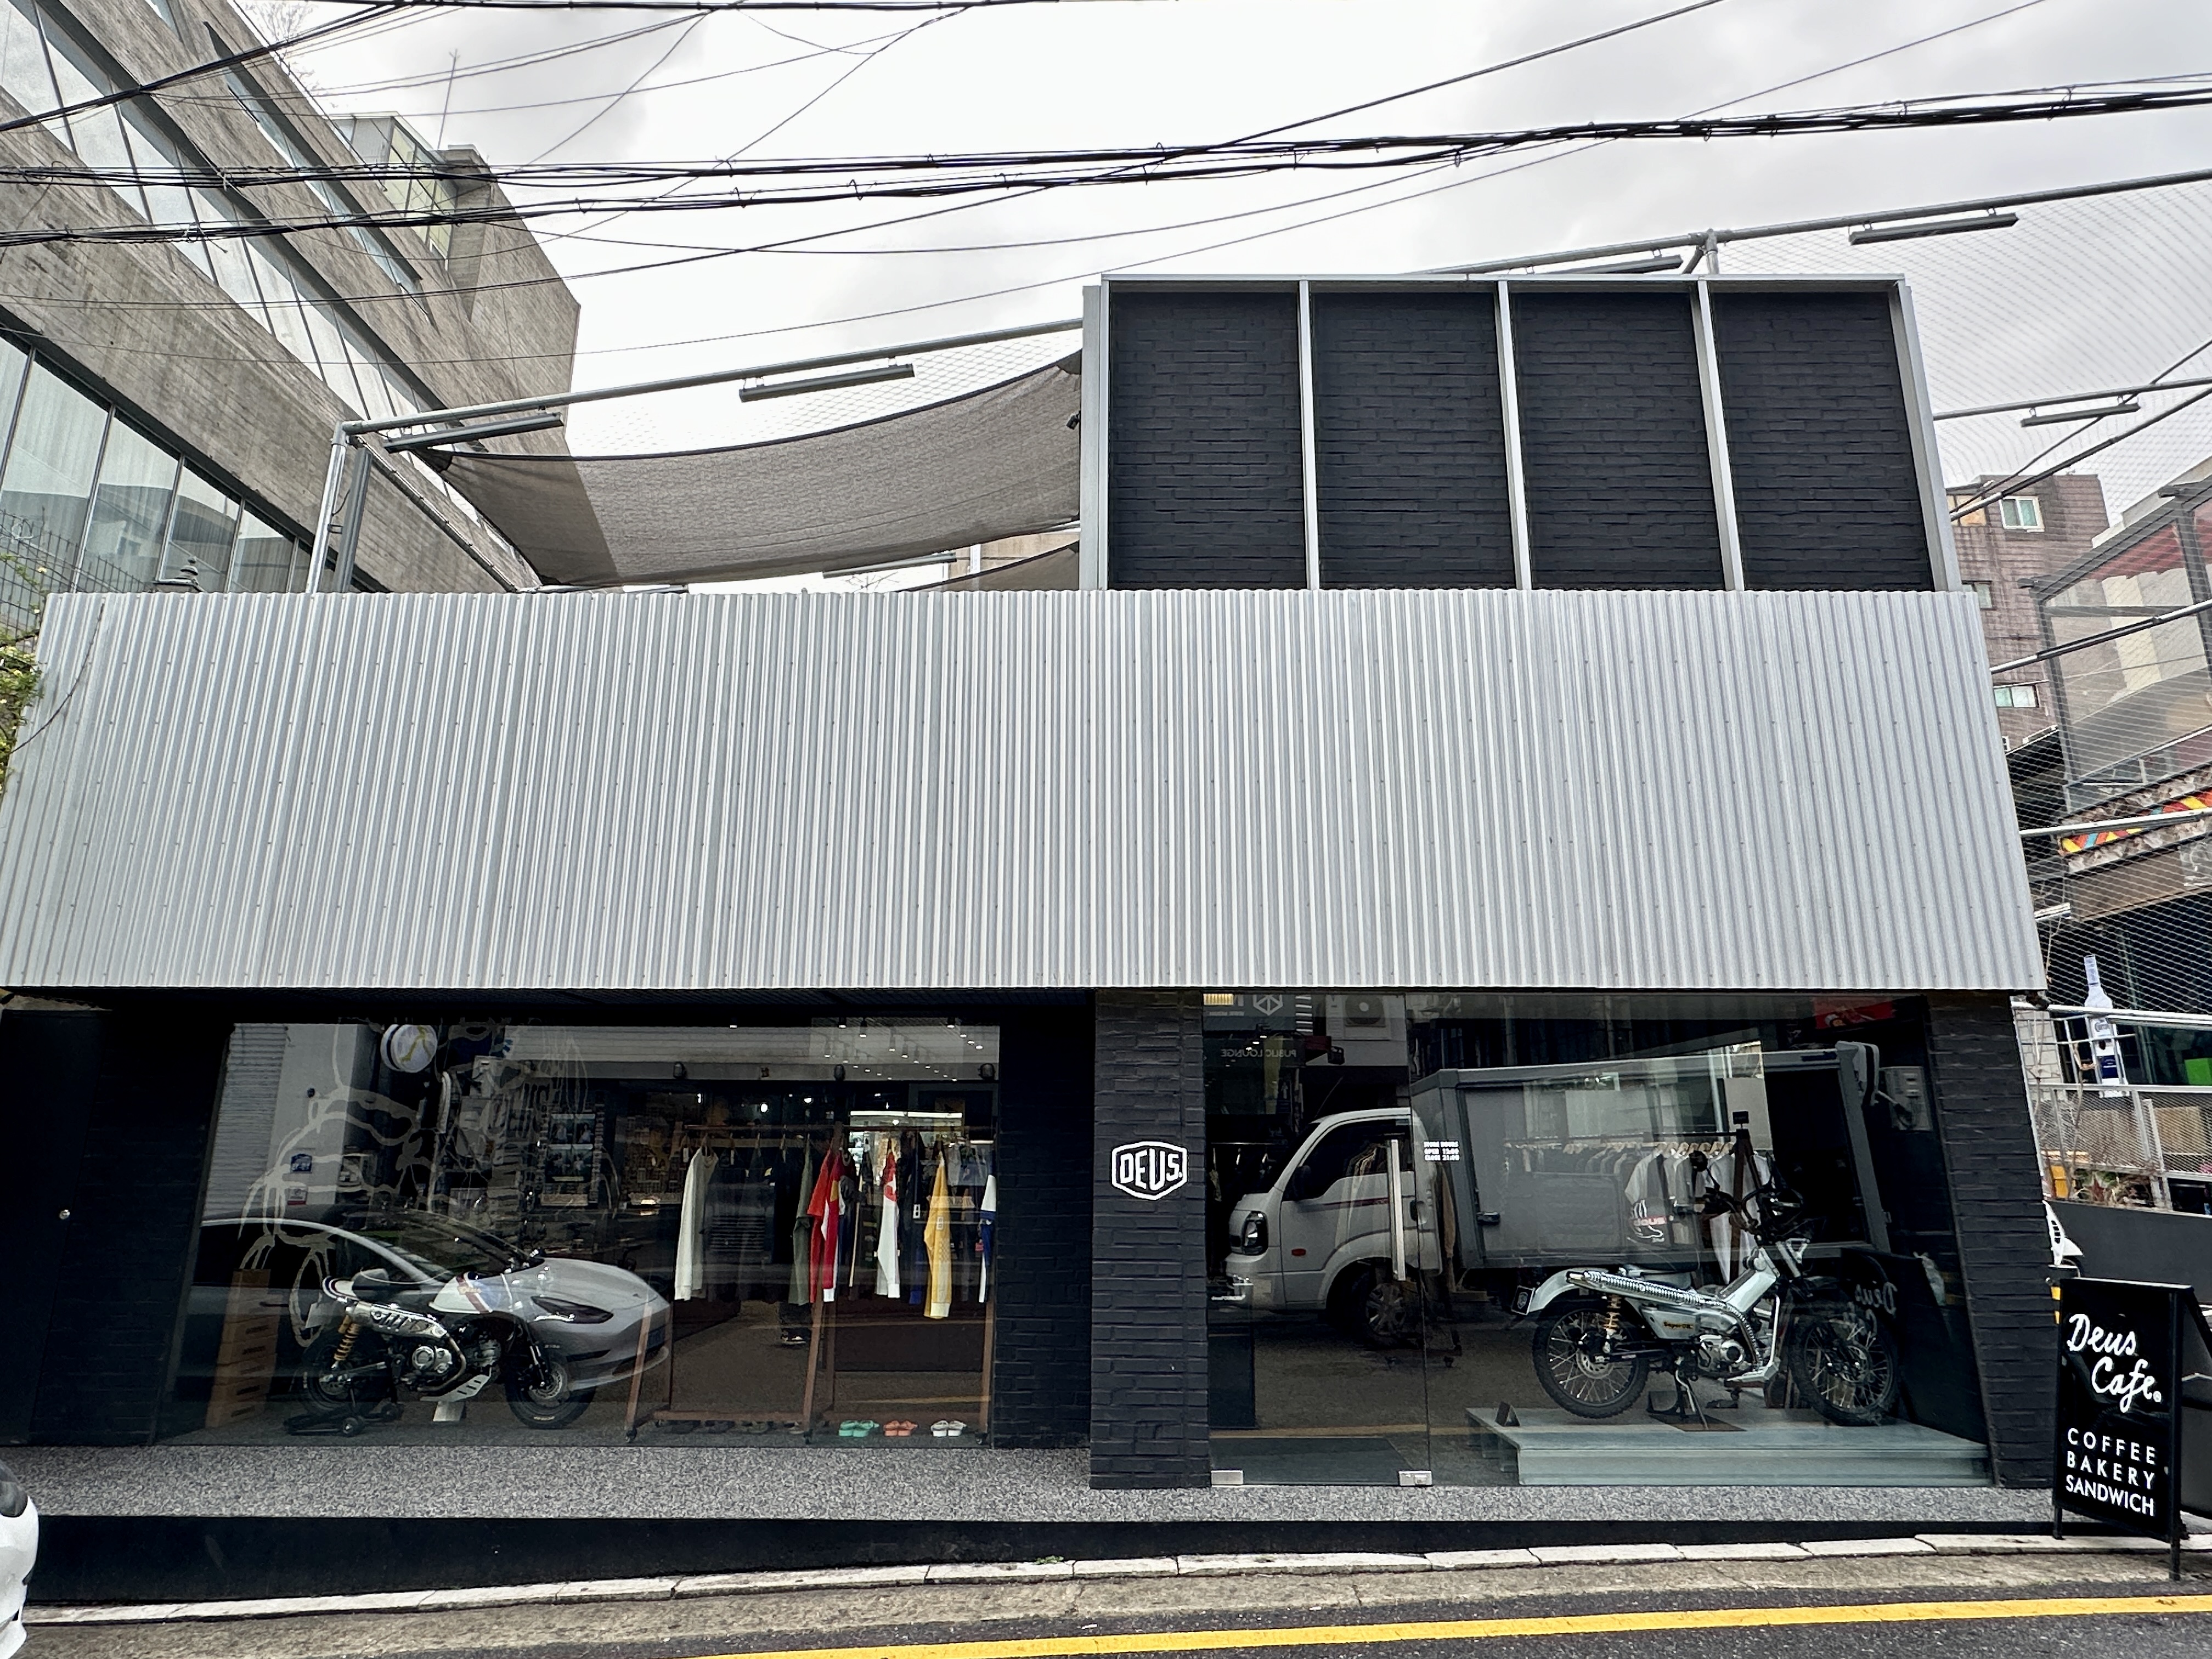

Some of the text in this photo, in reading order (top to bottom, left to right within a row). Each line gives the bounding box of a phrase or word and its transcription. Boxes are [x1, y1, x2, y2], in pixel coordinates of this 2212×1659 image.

[2067, 1313, 2137, 1356] Deus
[2067, 1427, 2157, 1465] COFFEE
[2067, 1451, 2155, 1490] BAKERY
[2065, 1474, 2155, 1517] SANDWICH
